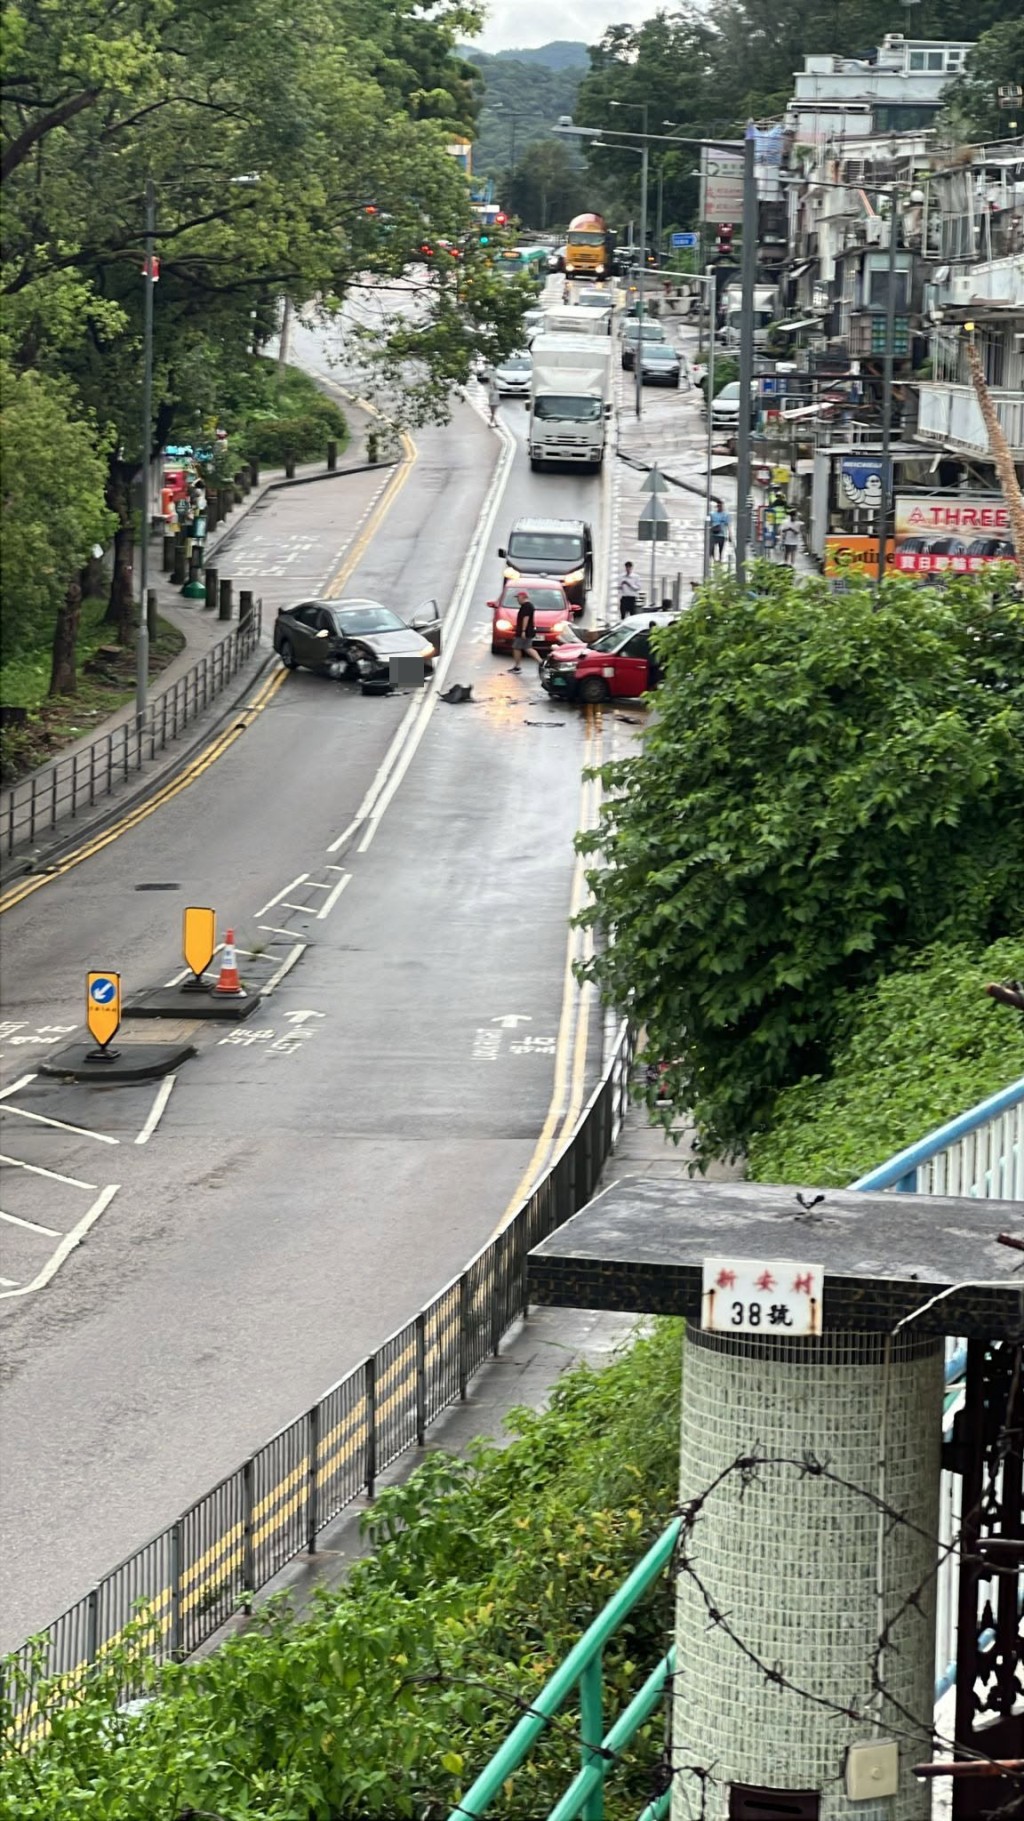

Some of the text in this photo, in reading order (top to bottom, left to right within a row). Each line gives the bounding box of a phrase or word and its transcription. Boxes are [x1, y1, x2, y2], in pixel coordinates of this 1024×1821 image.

[929, 507, 1008, 527] THREE
[715, 1268, 814, 1295] 新安村
[731, 1301, 793, 1327] 38號
